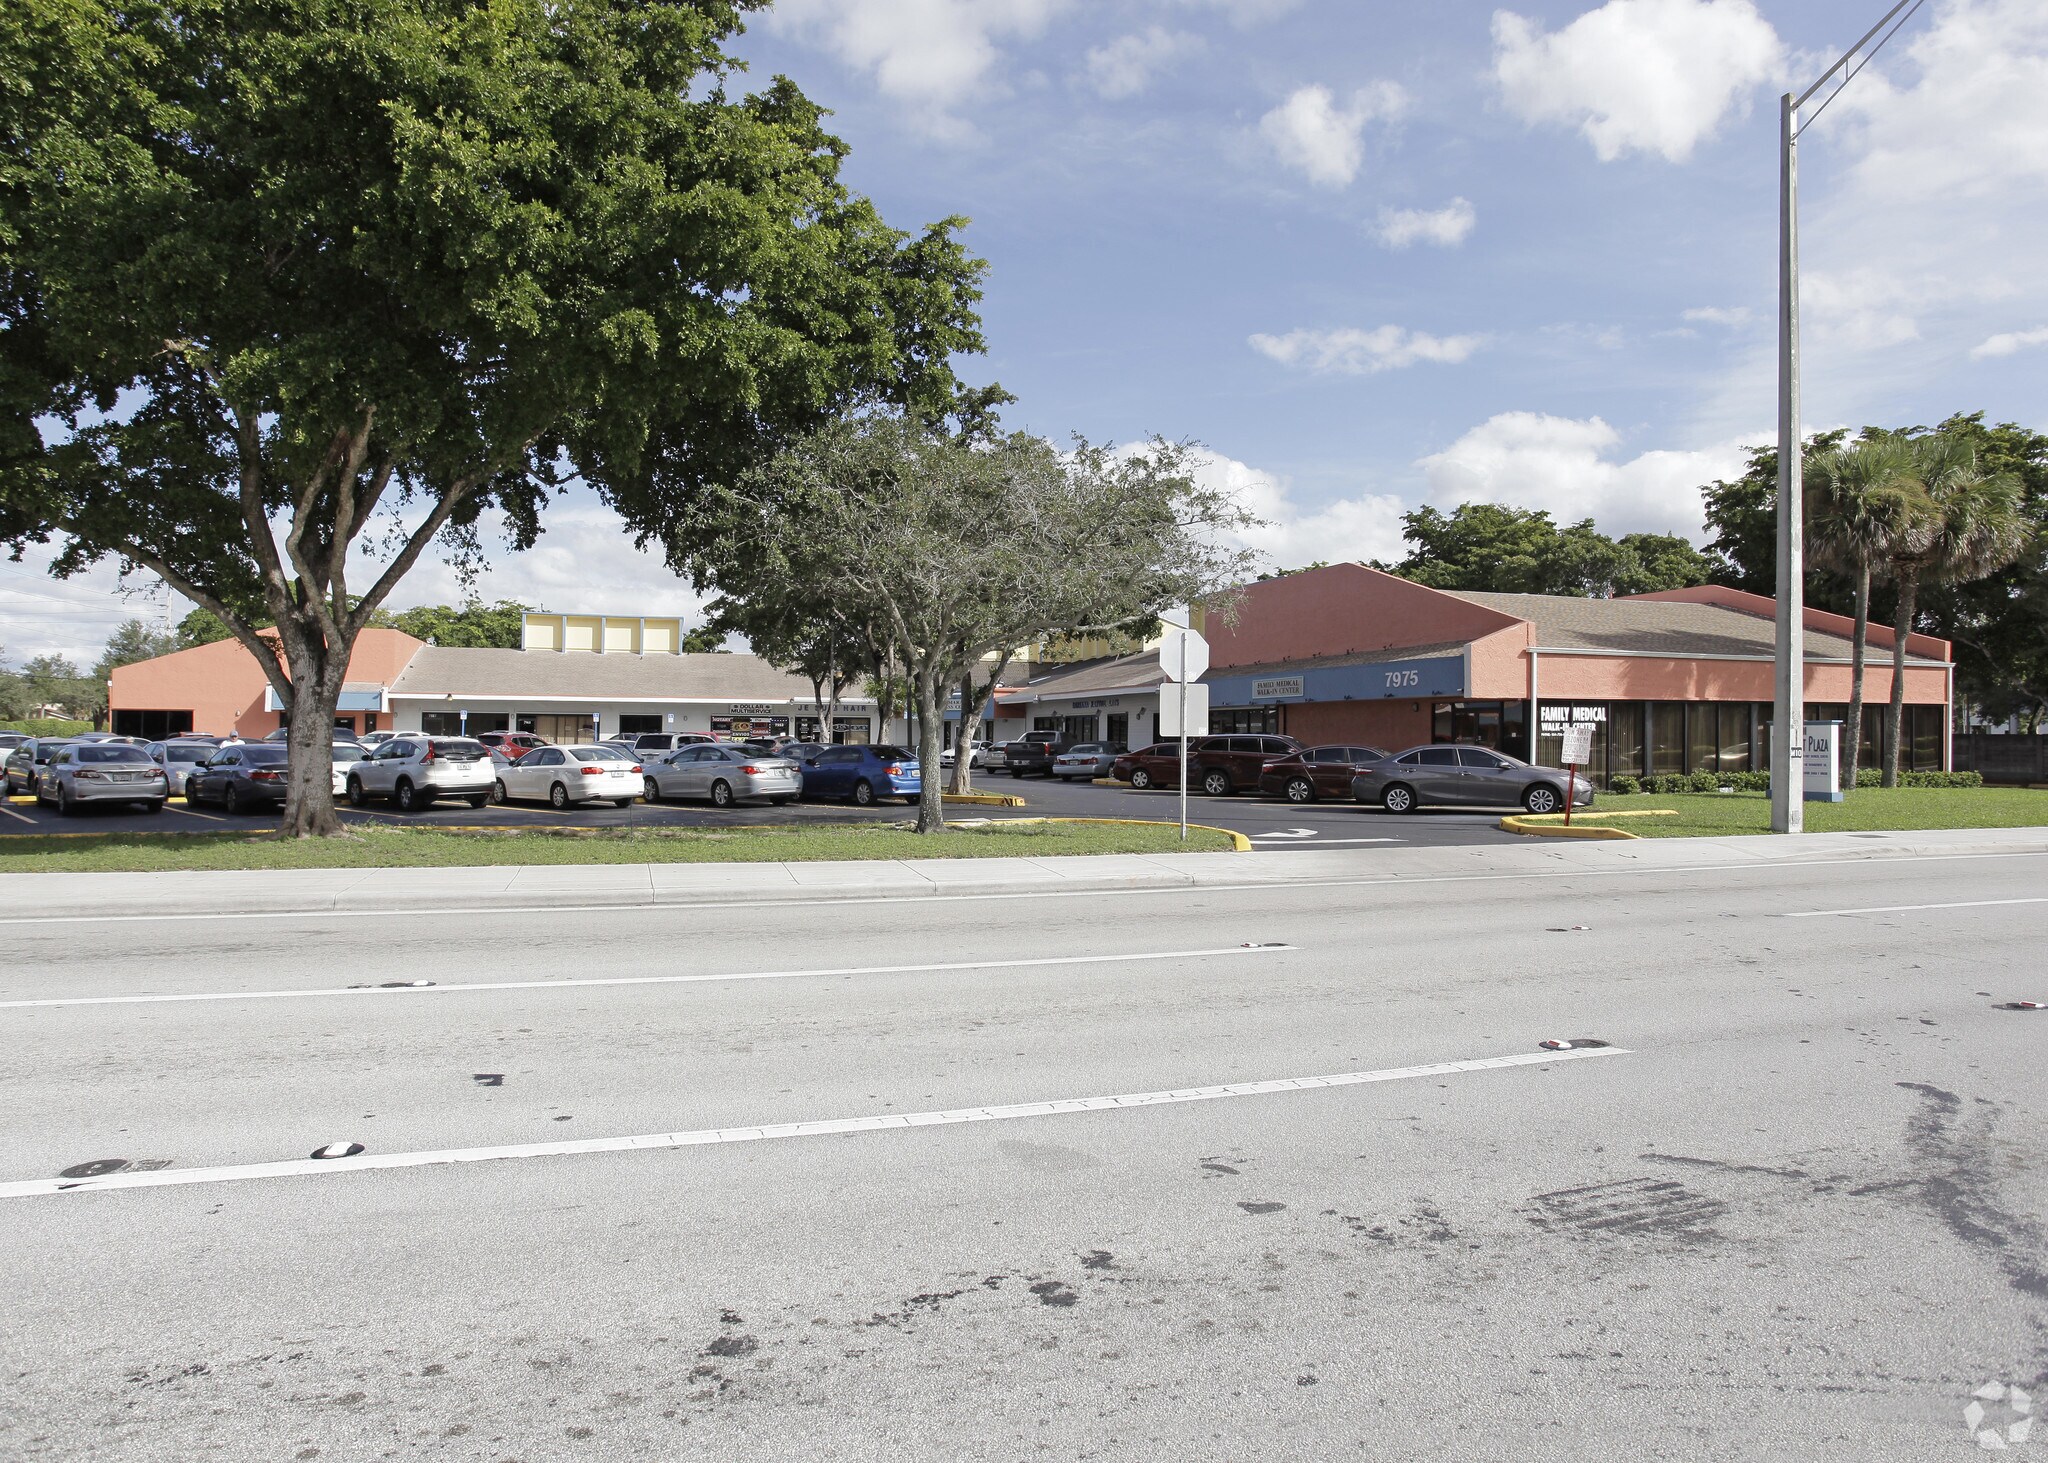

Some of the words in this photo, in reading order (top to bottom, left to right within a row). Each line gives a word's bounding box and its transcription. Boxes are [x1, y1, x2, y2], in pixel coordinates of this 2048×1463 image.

[1257, 681, 1275, 689] FAMILY
[1276, 679, 1300, 687] MEDICAL
[1385, 670, 1419, 688] 7975
[1257, 687, 1278, 696] WALK-IN
[1279, 686, 1300, 695] CENTER
[1541, 706, 1570, 721] FAMILY
[1573, 706, 1607, 721] MEDICAL
[1541, 722, 1570, 732] WALK-IN
[1573, 722, 1597, 731] CENTER
[1808, 735, 1829, 752] PLAZA
